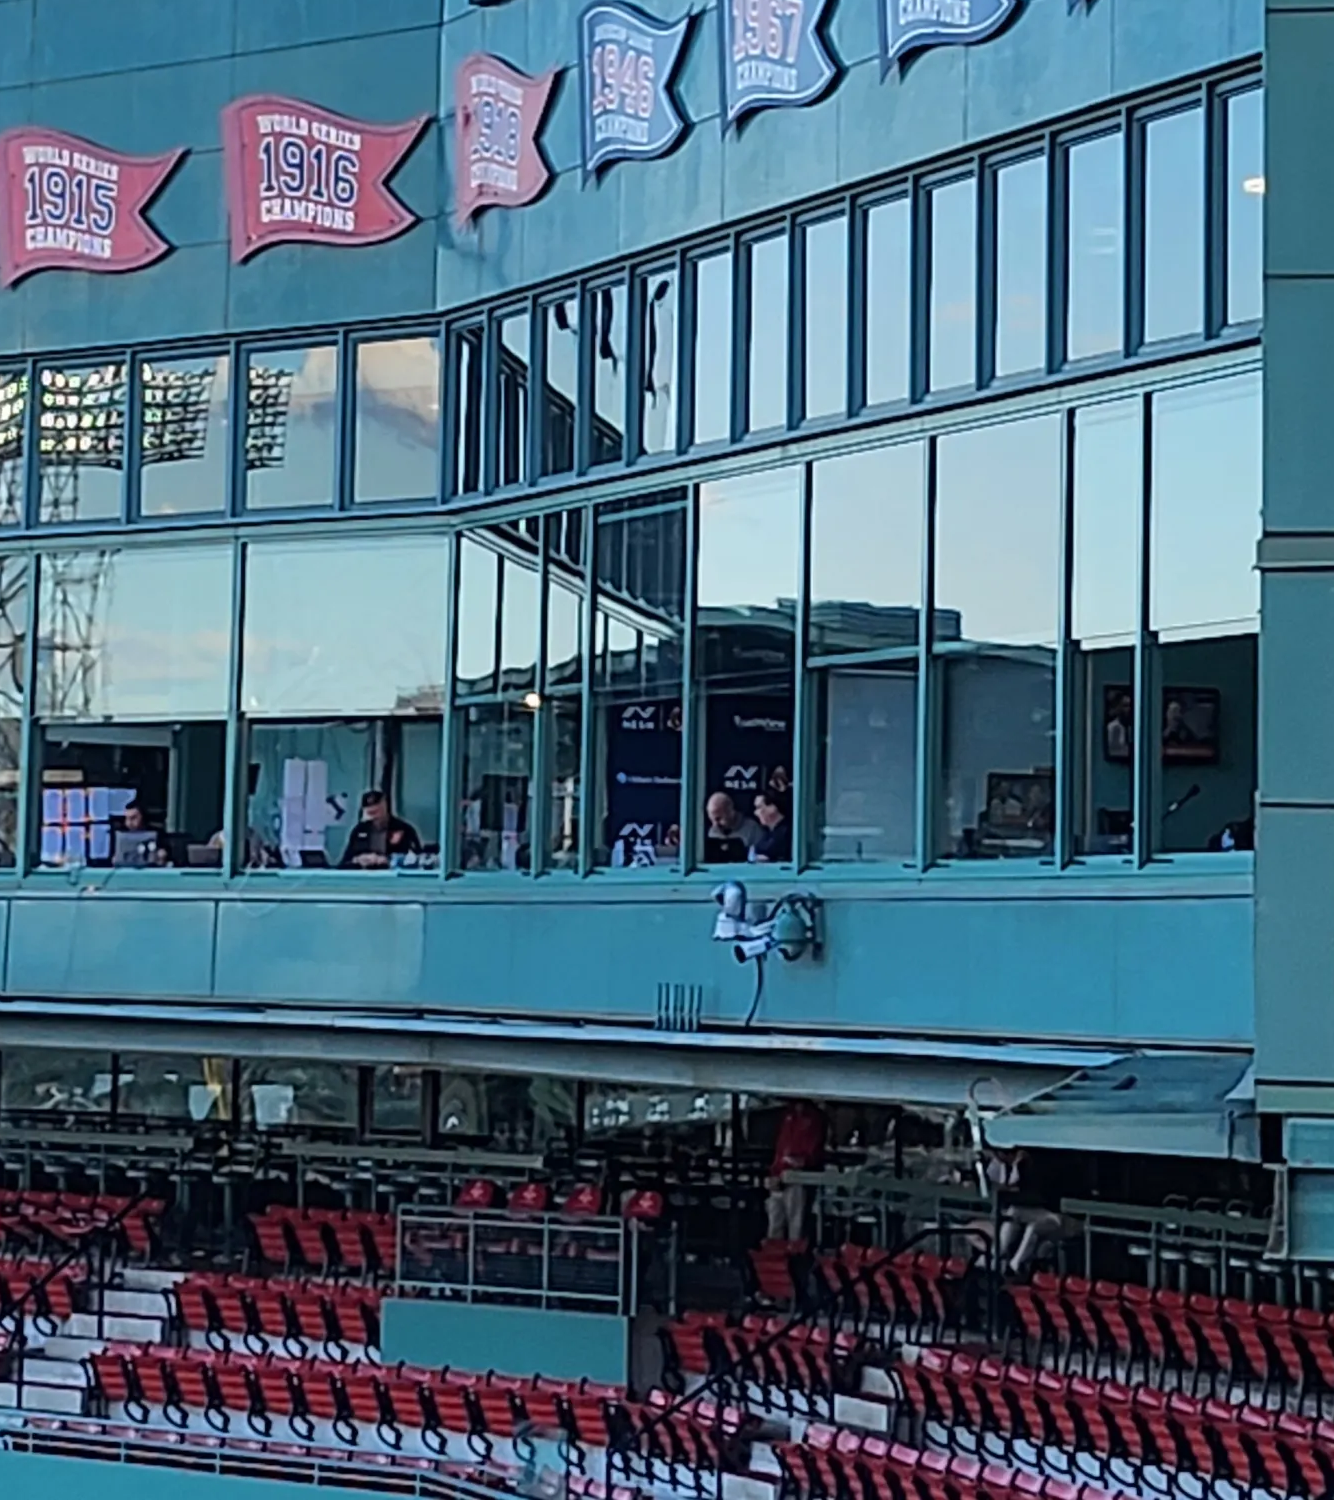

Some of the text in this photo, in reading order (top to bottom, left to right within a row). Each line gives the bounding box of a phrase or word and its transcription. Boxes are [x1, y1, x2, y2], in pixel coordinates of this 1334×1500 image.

[592, 44, 655, 118] 1946
[256, 114, 361, 151] WORLD SERIES
[22, 145, 119, 181] WORLD SERIES
[259, 136, 359, 208] 1916
[24, 166, 118, 236] 1915
[261, 198, 355, 232] CHAMPIONS
[25, 225, 112, 259] CHAMPIONS
